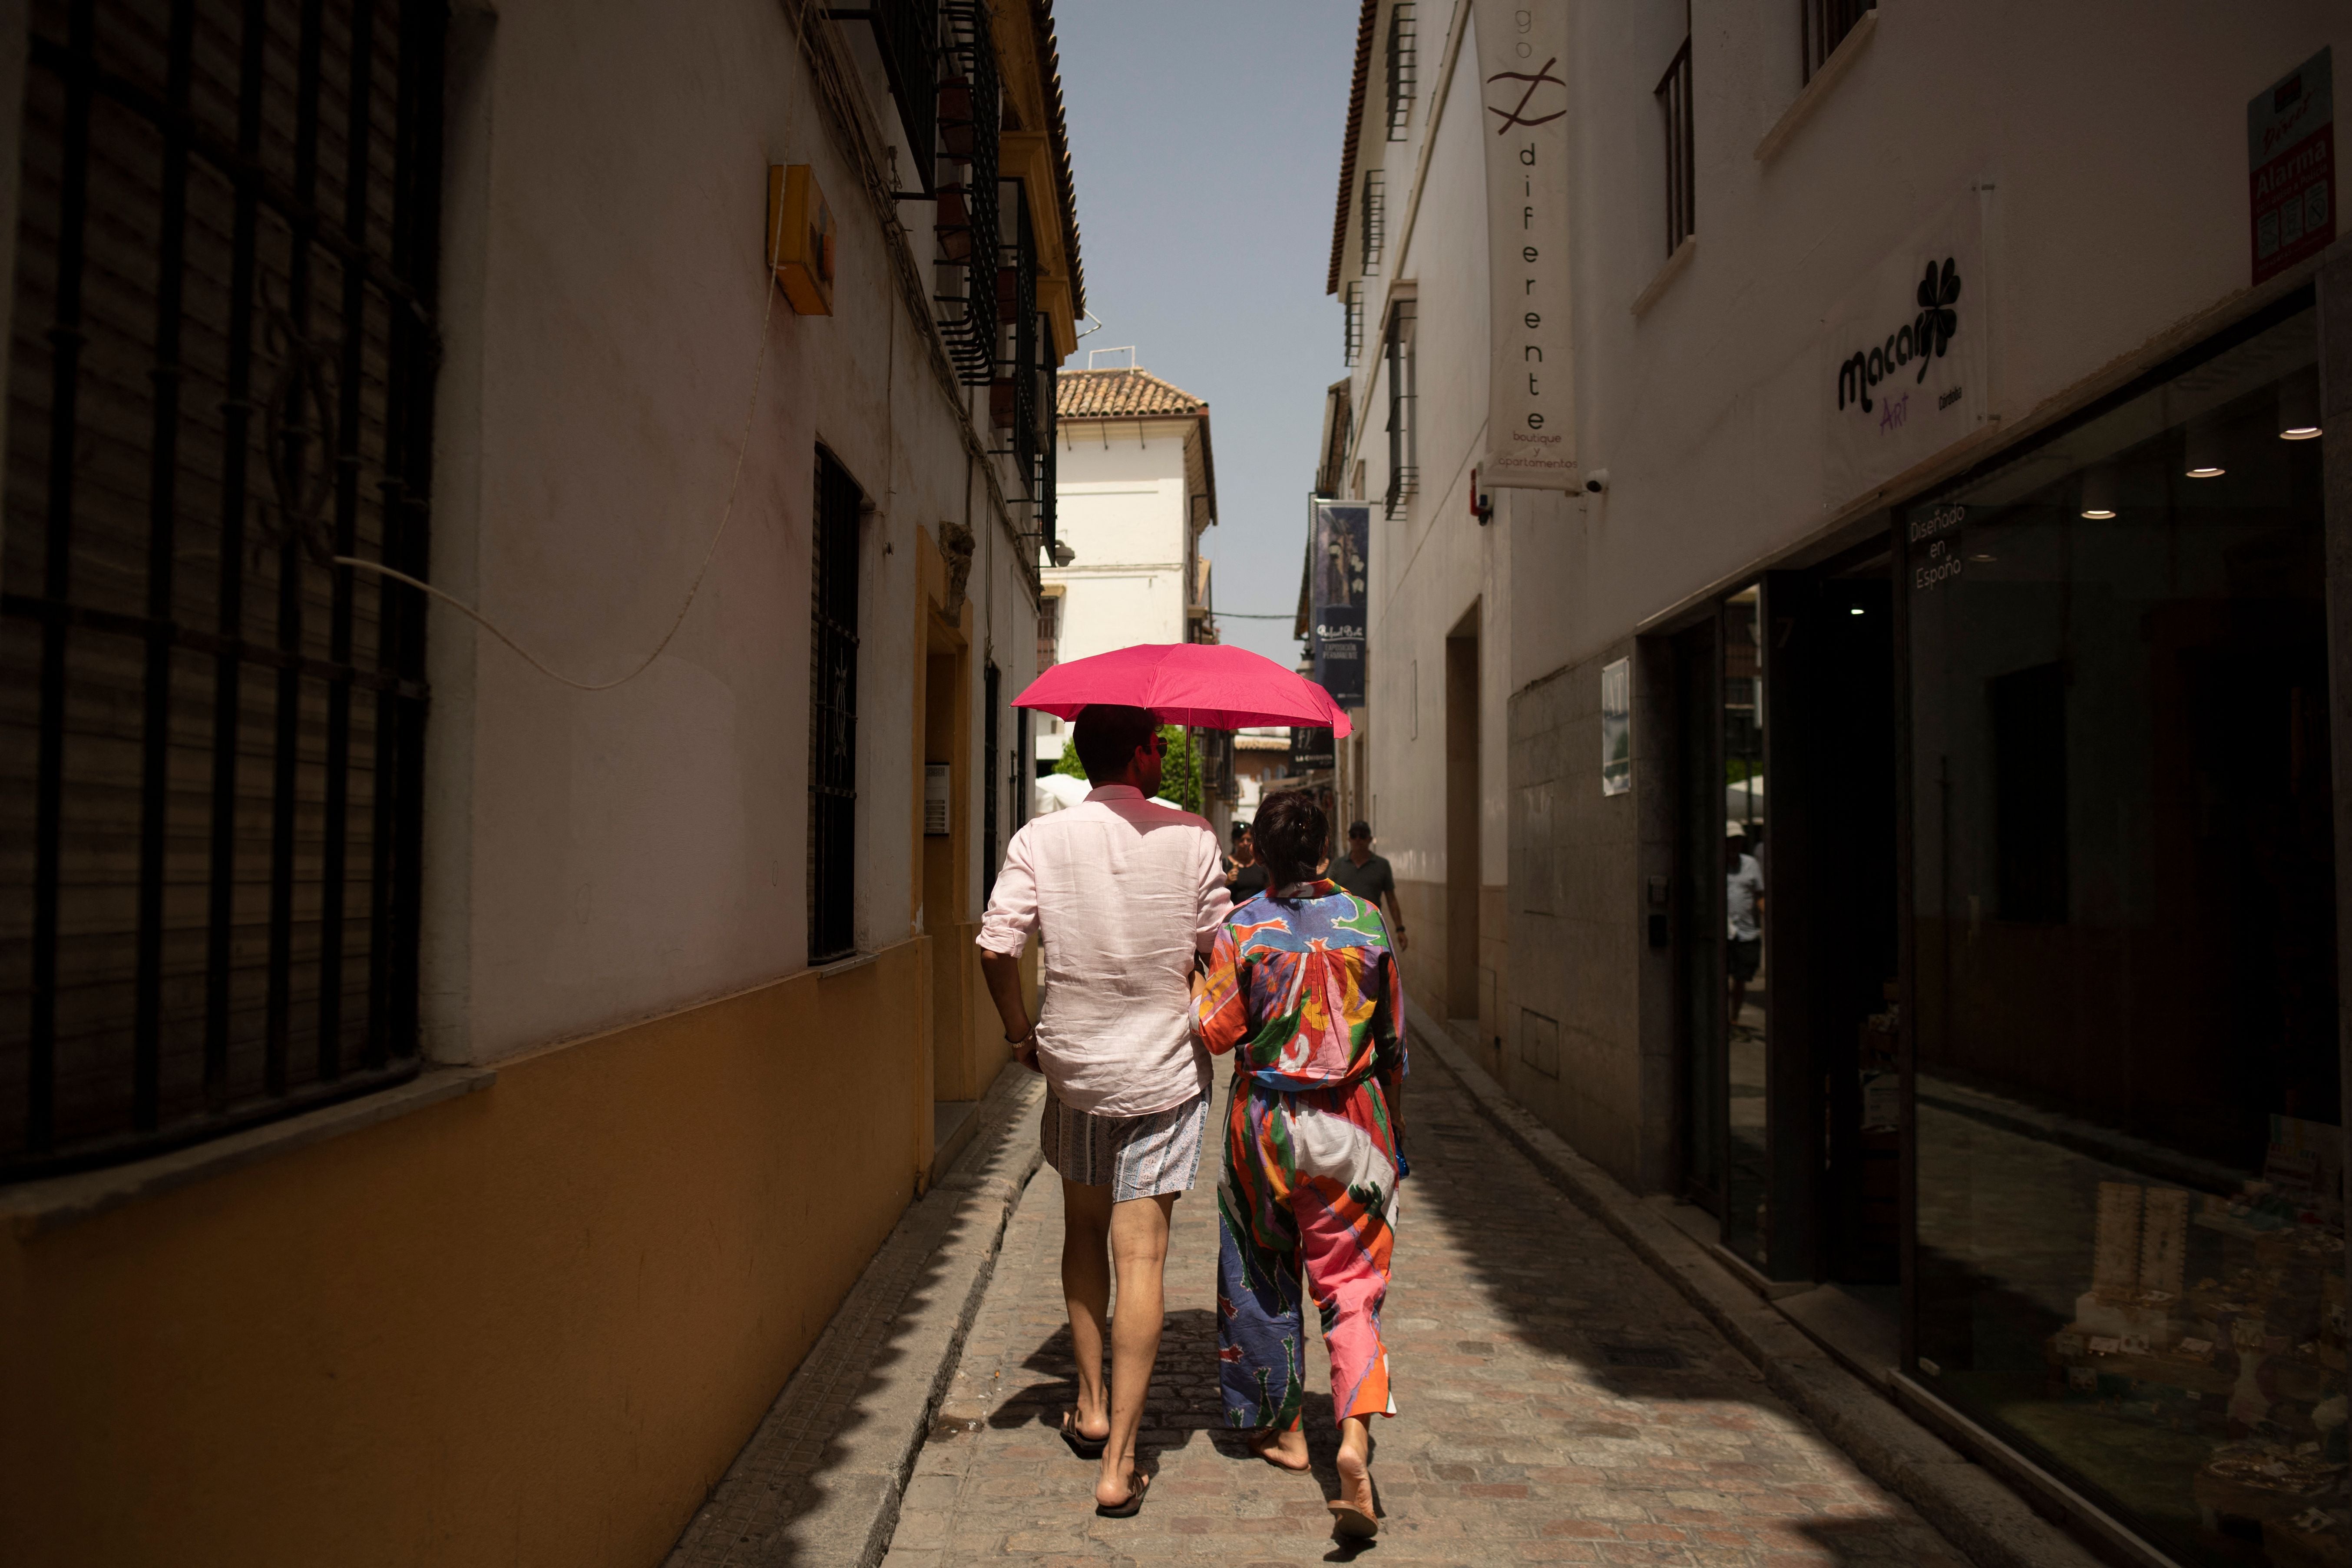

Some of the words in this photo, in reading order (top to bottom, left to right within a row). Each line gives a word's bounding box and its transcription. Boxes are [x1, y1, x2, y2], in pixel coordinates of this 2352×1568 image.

[2256, 139, 2327, 200] Alarma
[2256, 199, 2271, 214] con
[2272, 186, 2292, 205] aviso
[2293, 181, 2299, 191] a
[1519, 143, 1545, 430] diferente
[1513, 431, 1562, 446] boutique
[1534, 447, 1541, 457] y
[1499, 458, 1578, 469] apartamentos
[1910, 502, 1965, 543] Diseñado
[1930, 539, 1946, 558] en
[1915, 554, 1962, 591] España
[1776, 617, 1796, 648] 7
